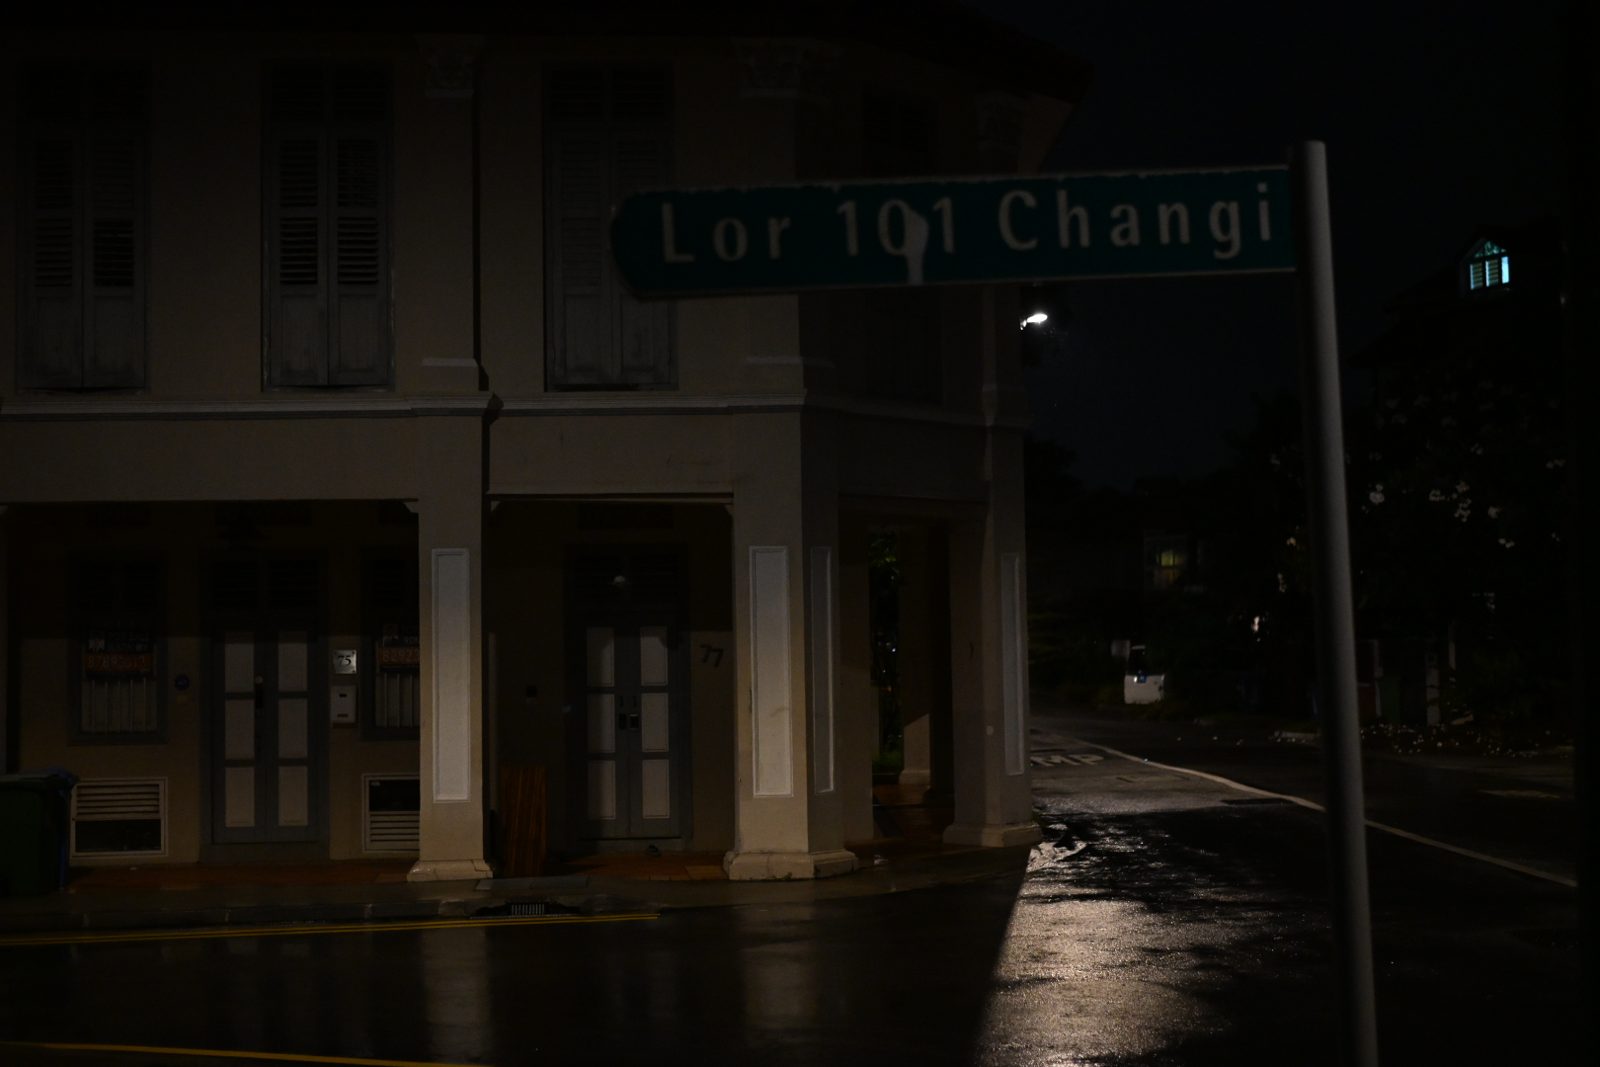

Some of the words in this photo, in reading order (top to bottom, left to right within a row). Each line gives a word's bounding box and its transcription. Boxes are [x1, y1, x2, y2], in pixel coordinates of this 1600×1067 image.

[660, 202, 793, 265] Lor
[836, 196, 958, 257] 101
[997, 181, 1273, 260] Changi
[336, 654, 352, 668] 75
[700, 644, 724, 668] 77
